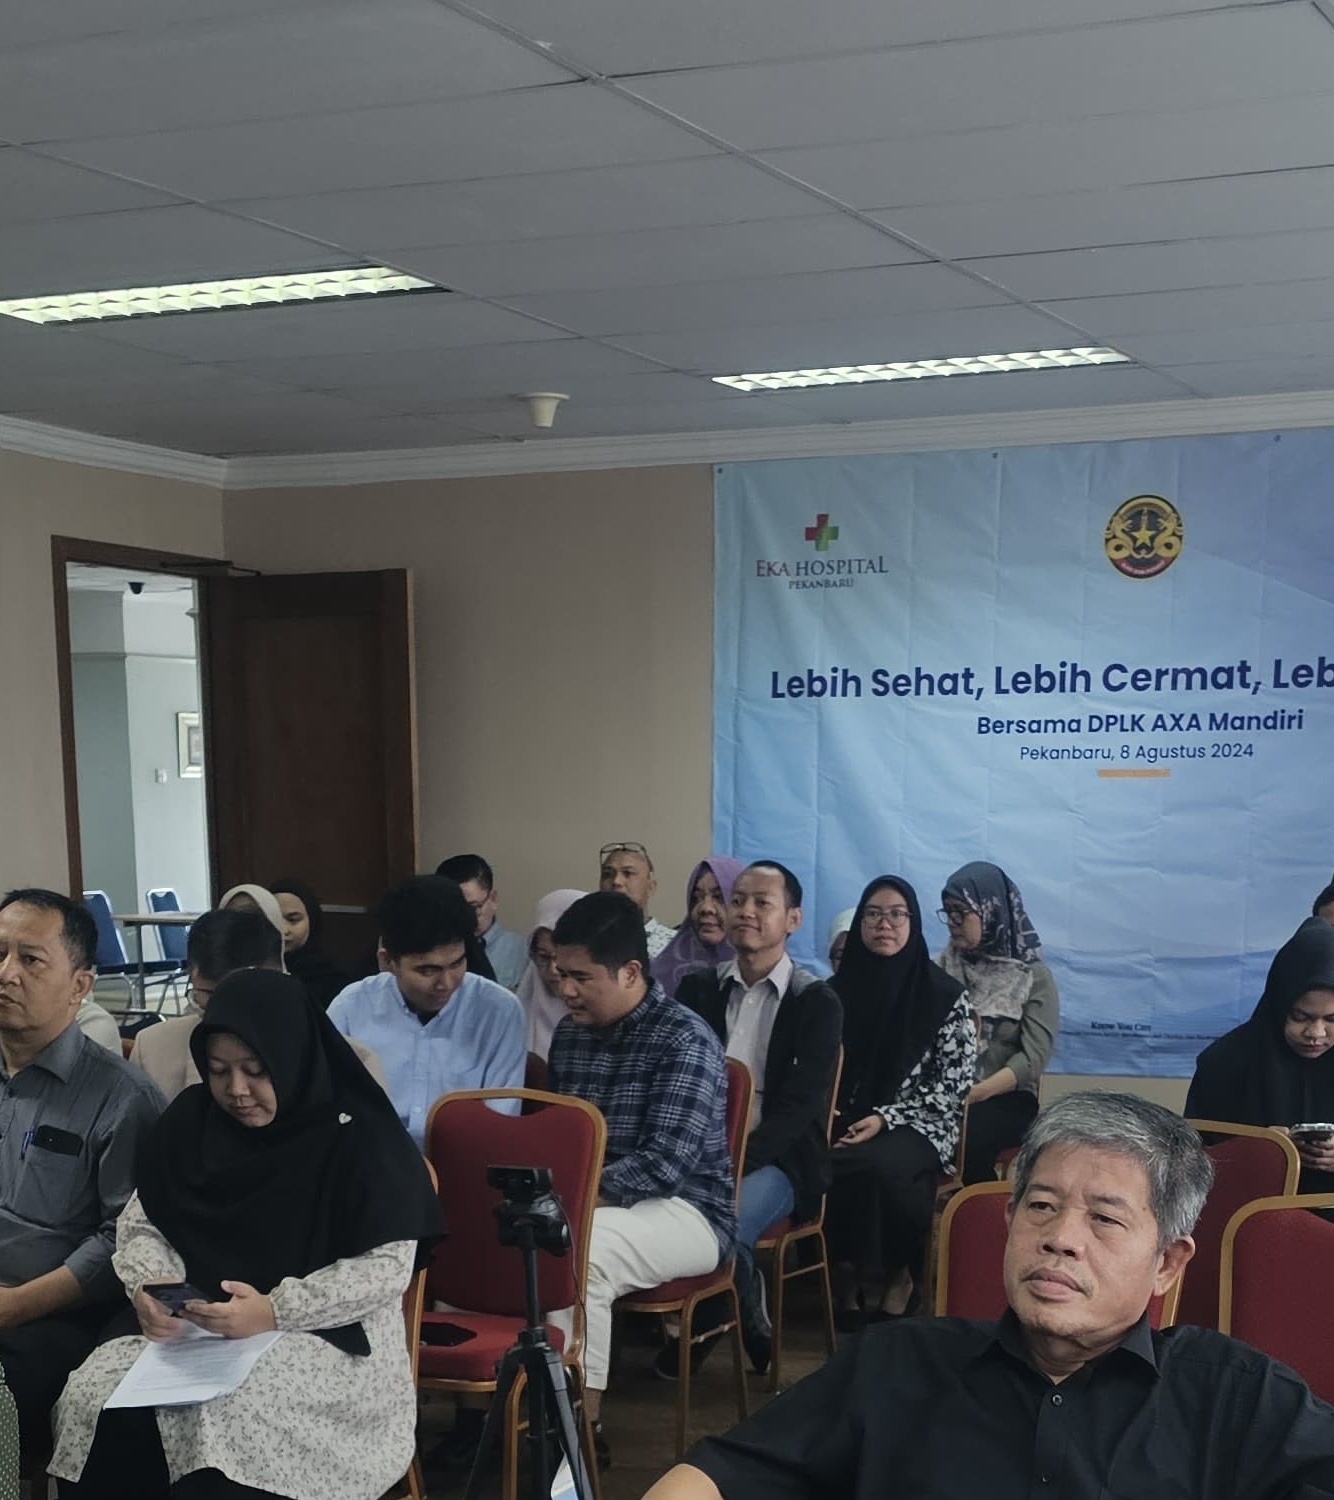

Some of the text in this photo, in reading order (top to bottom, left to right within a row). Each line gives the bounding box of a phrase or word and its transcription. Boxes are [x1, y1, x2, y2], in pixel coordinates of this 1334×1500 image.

[756, 556, 889, 577] EKA HOSPITAL
[789, 578, 854, 590] PEKANBARU
[771, 666, 862, 699] Lebih
[871, 665, 984, 701] Sehat,
[994, 661, 1091, 695] Lebih
[1102, 660, 1262, 695] Cermat,
[977, 709, 1304, 735] Bersama DPLK AXA Mandiri
[1020, 743, 1254, 763] Pekanbaru, 8 Agustus 2024
